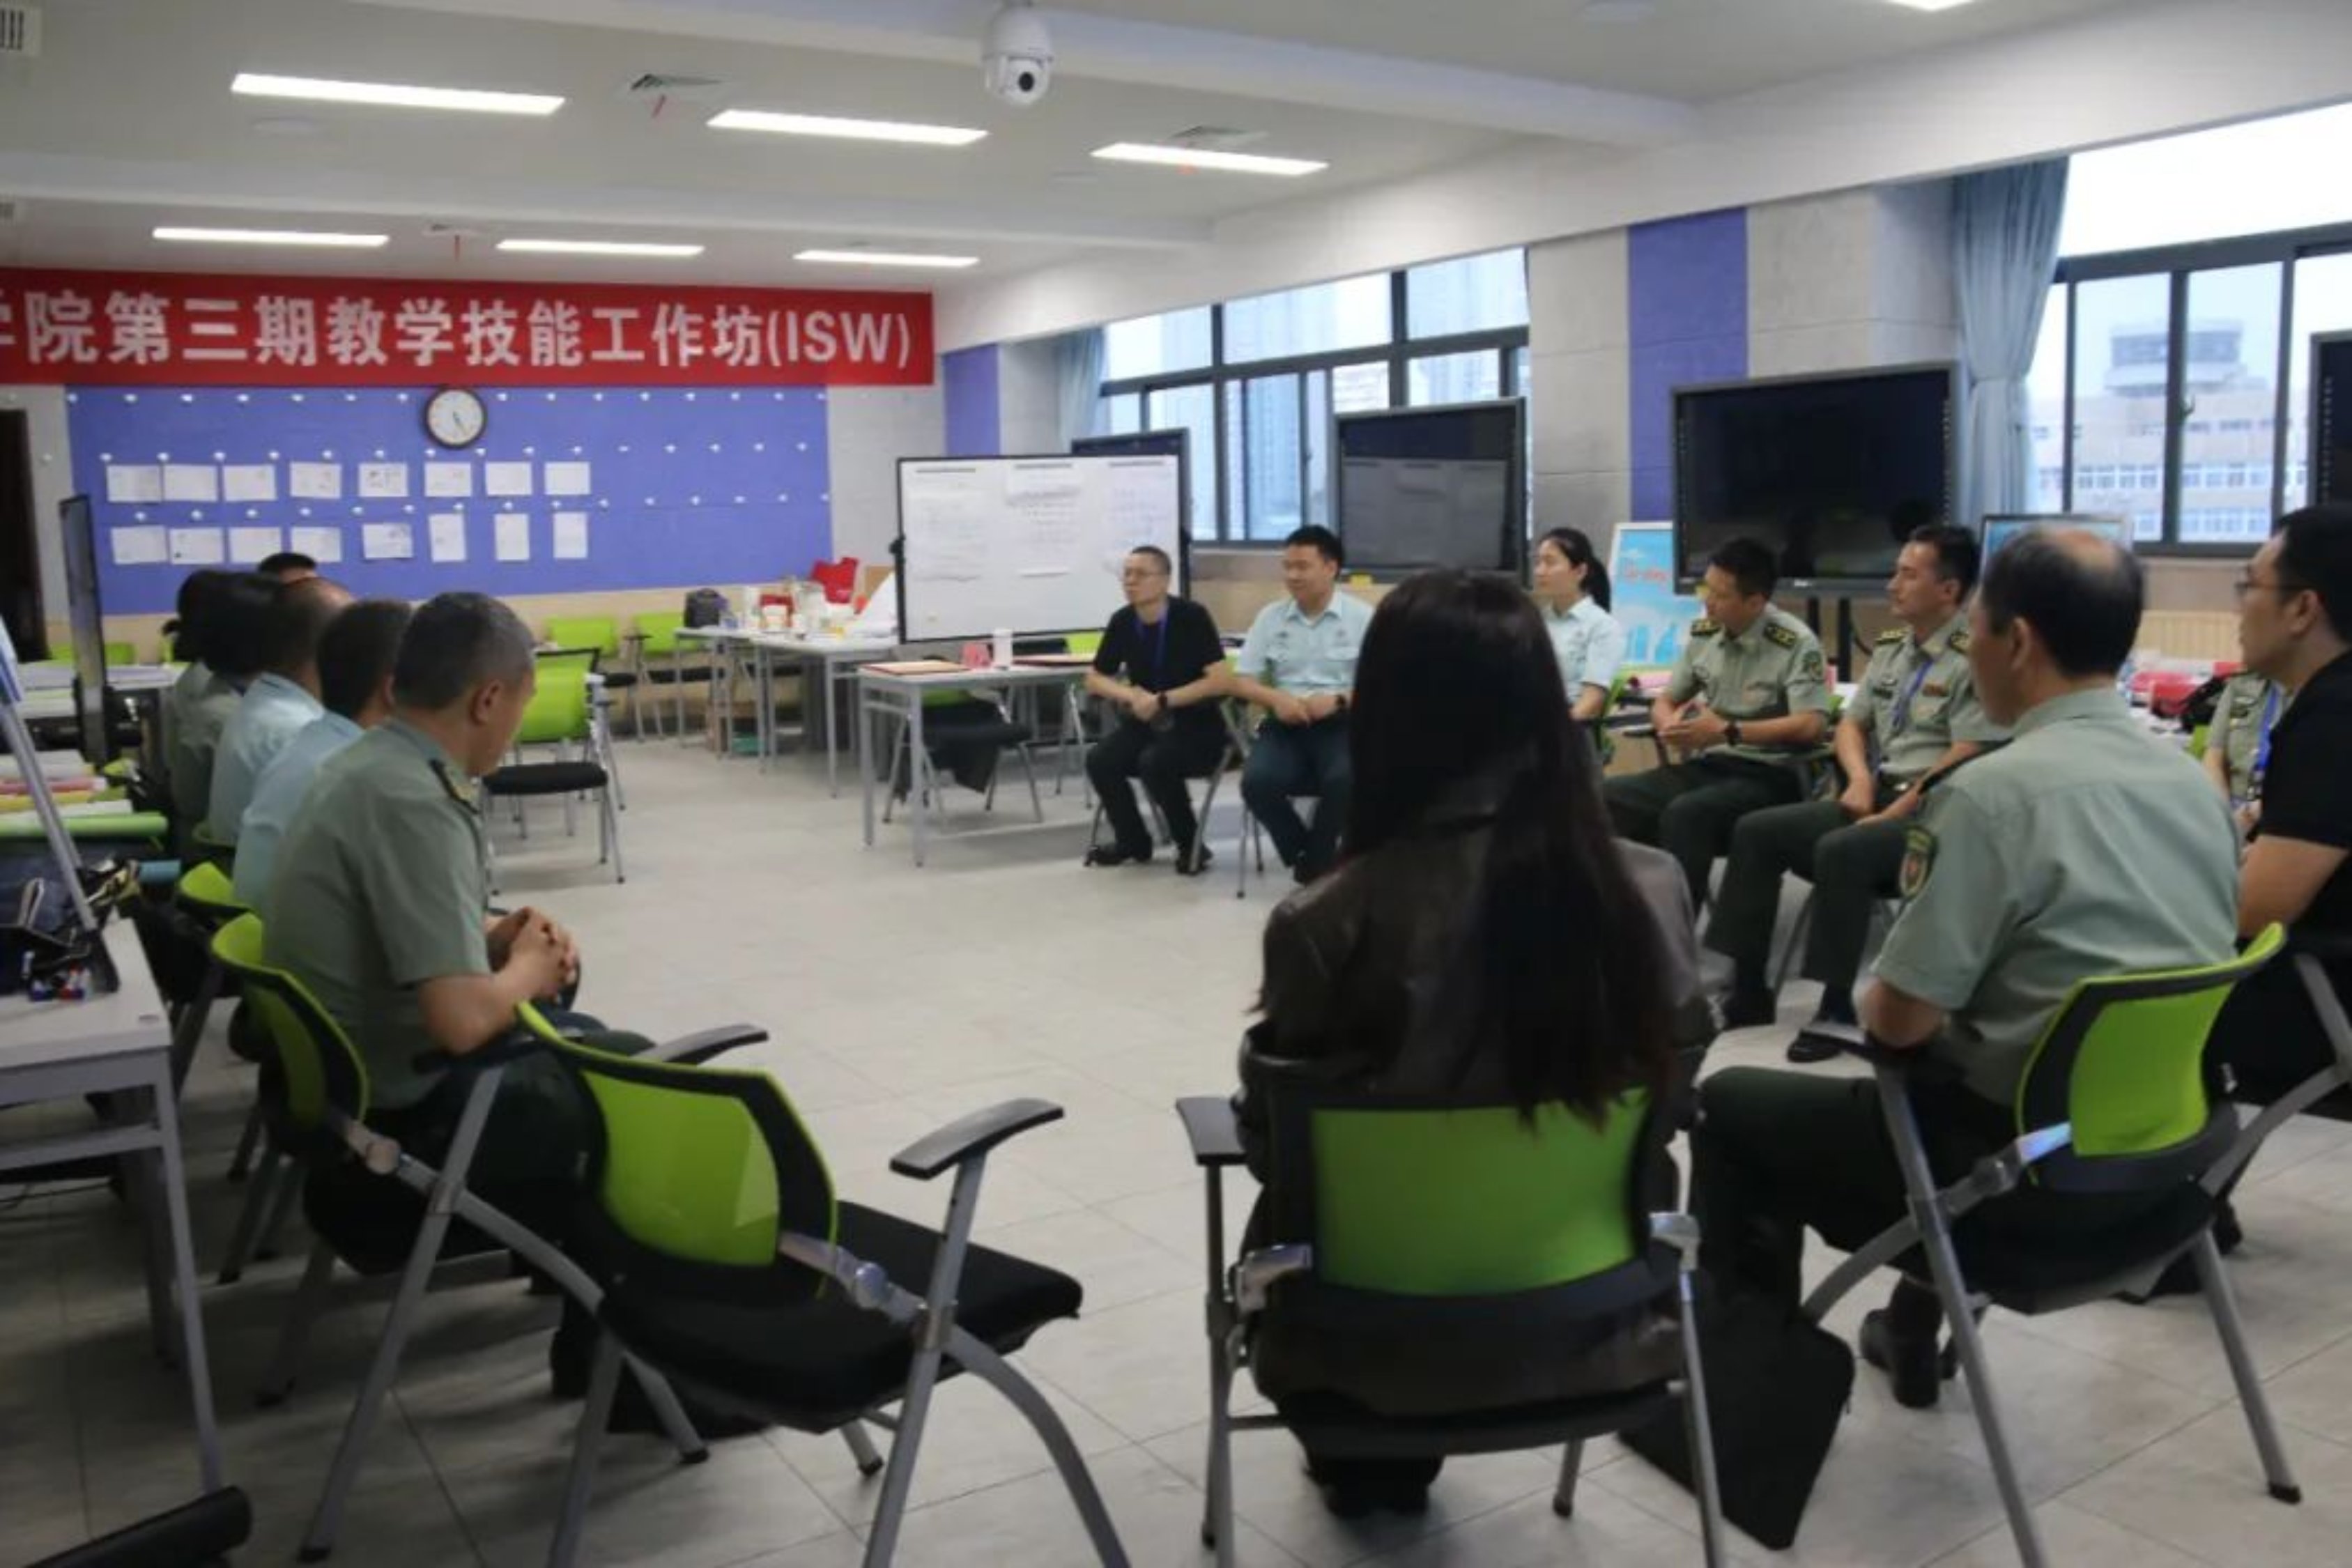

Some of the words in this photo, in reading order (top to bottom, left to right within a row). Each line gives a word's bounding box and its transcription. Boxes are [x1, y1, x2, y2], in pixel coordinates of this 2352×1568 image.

[0, 289, 910, 369] 院第三期教学技能工作坊(ISW)
